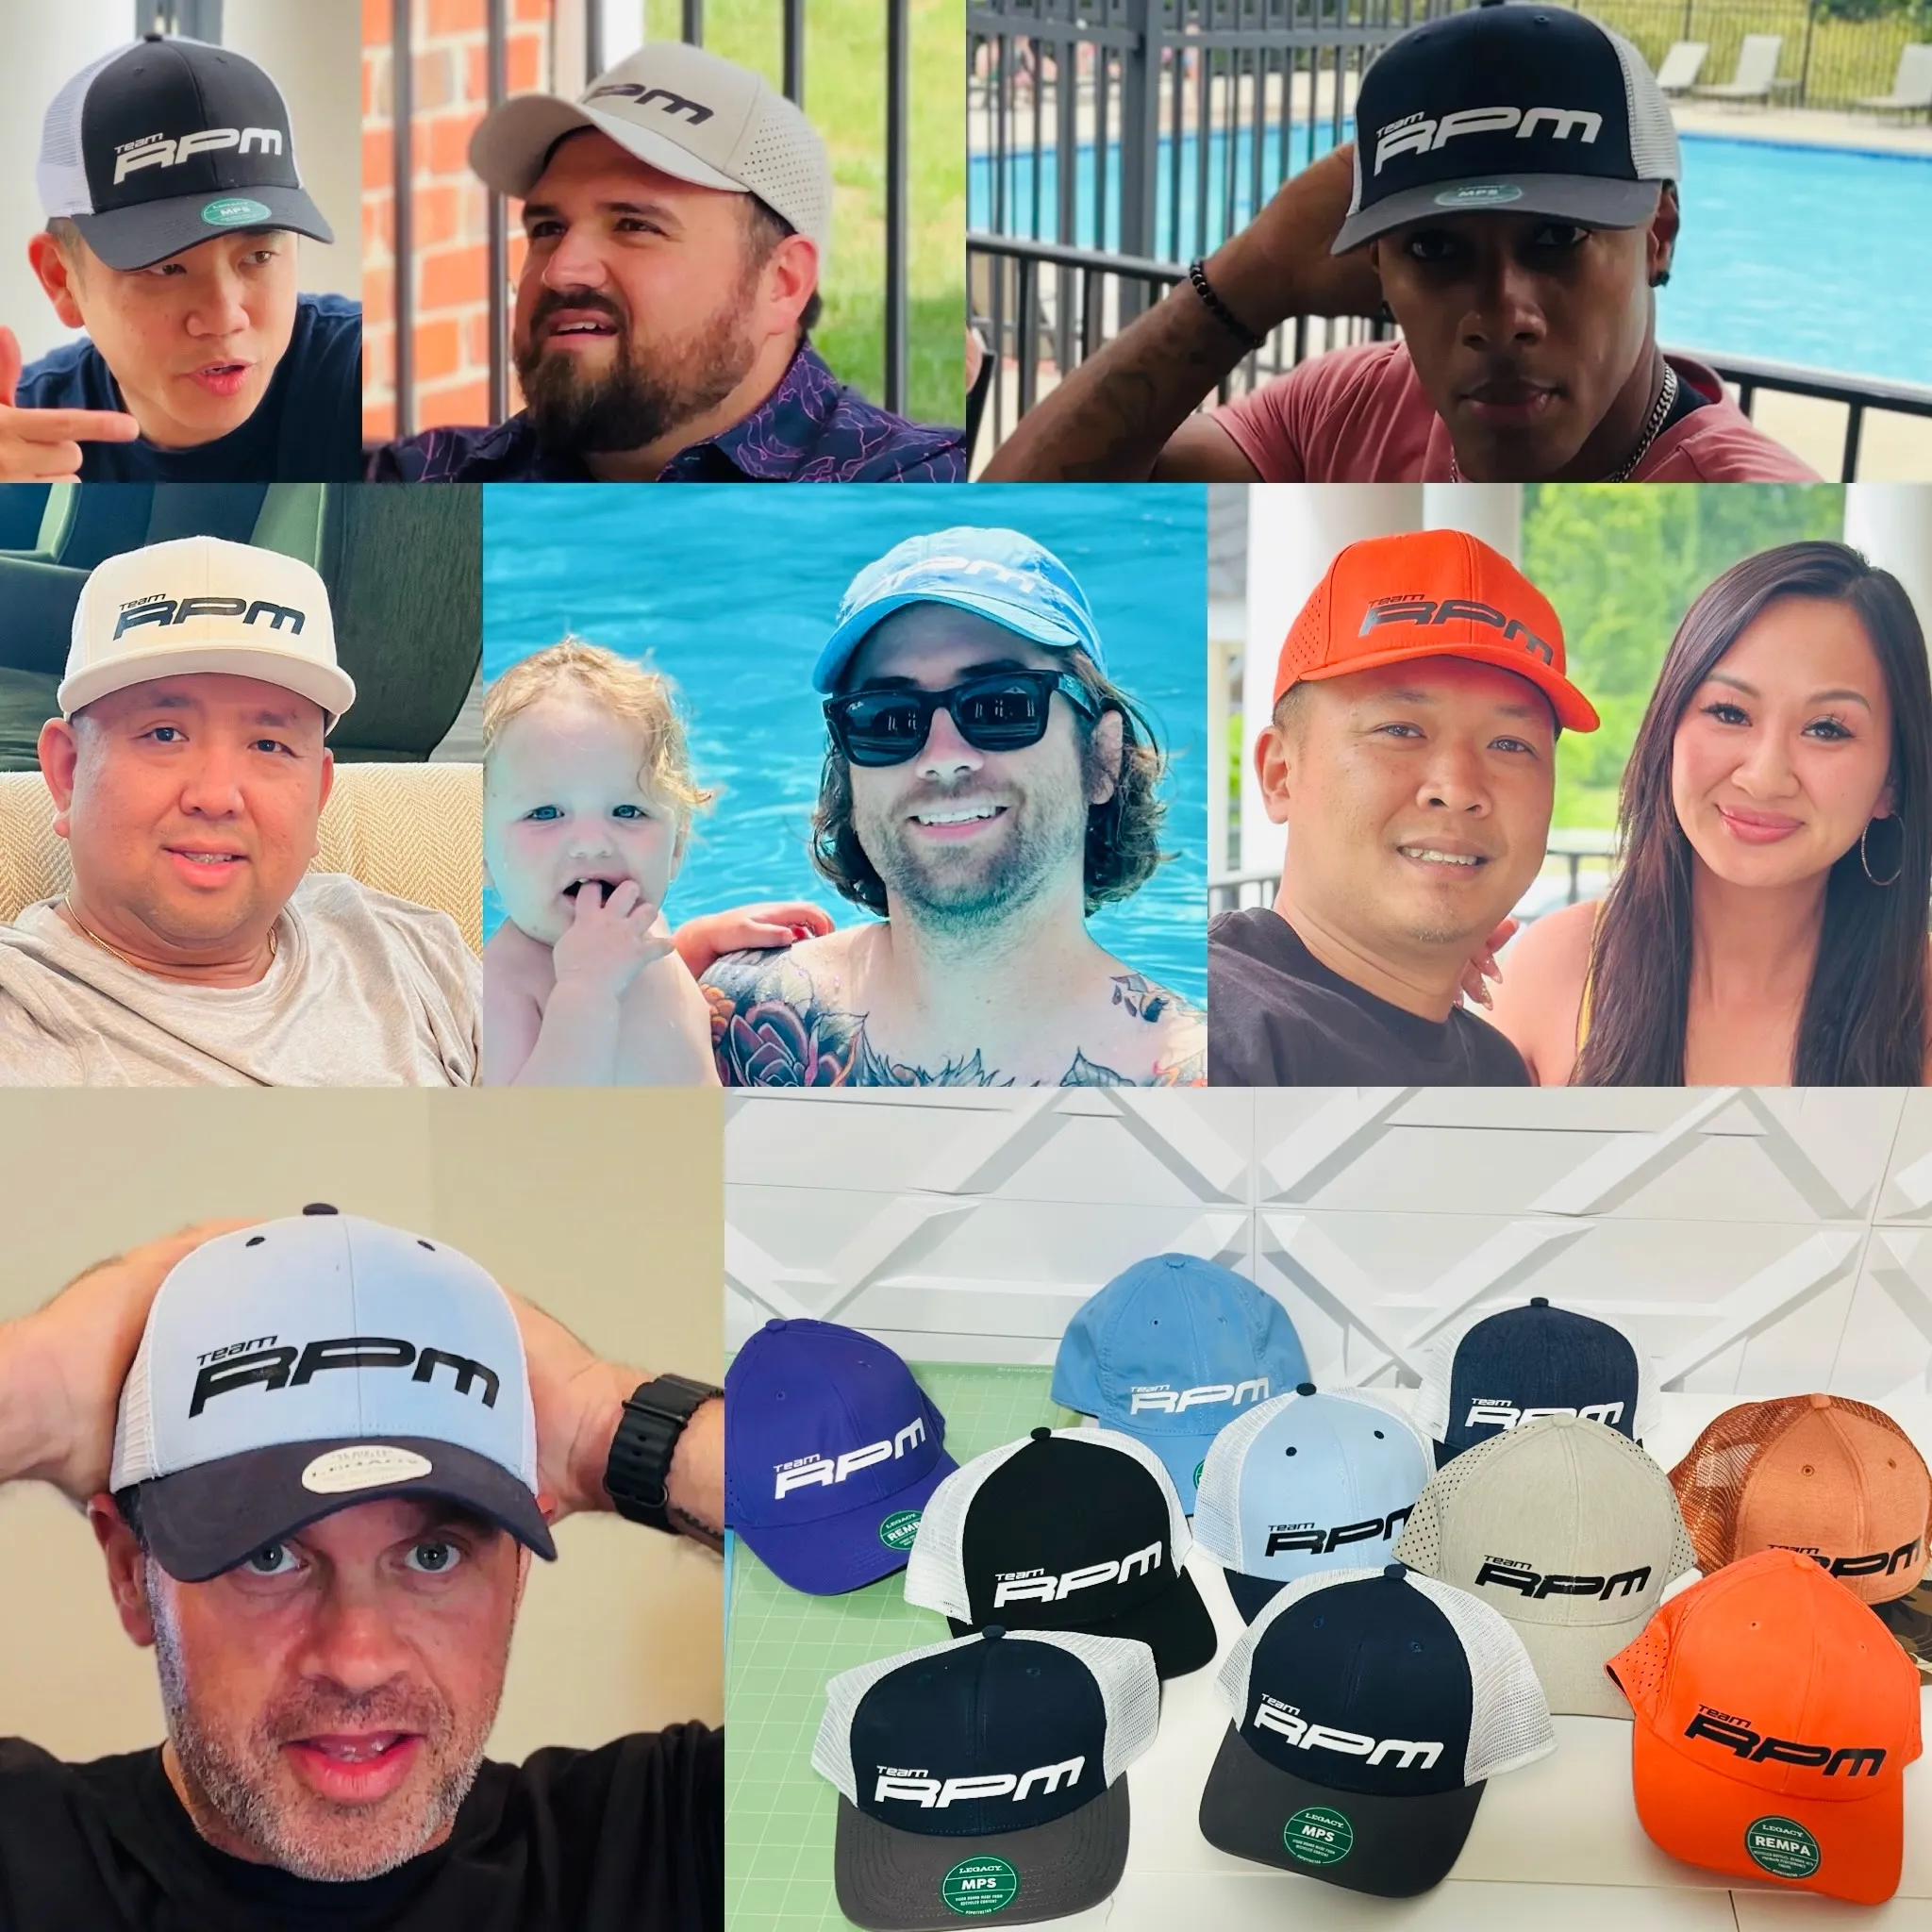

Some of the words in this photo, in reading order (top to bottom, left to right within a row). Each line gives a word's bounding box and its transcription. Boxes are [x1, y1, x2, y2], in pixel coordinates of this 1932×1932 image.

[887, 1521, 921, 1541] REMP
[1306, 1813, 1343, 1827] LEGACY
[1302, 1824, 1335, 1842] MPS
[1762, 1824, 1804, 1838] LEGACY
[1755, 1835, 1811, 1857] REMPA
[961, 1877, 996, 1890] MPS
